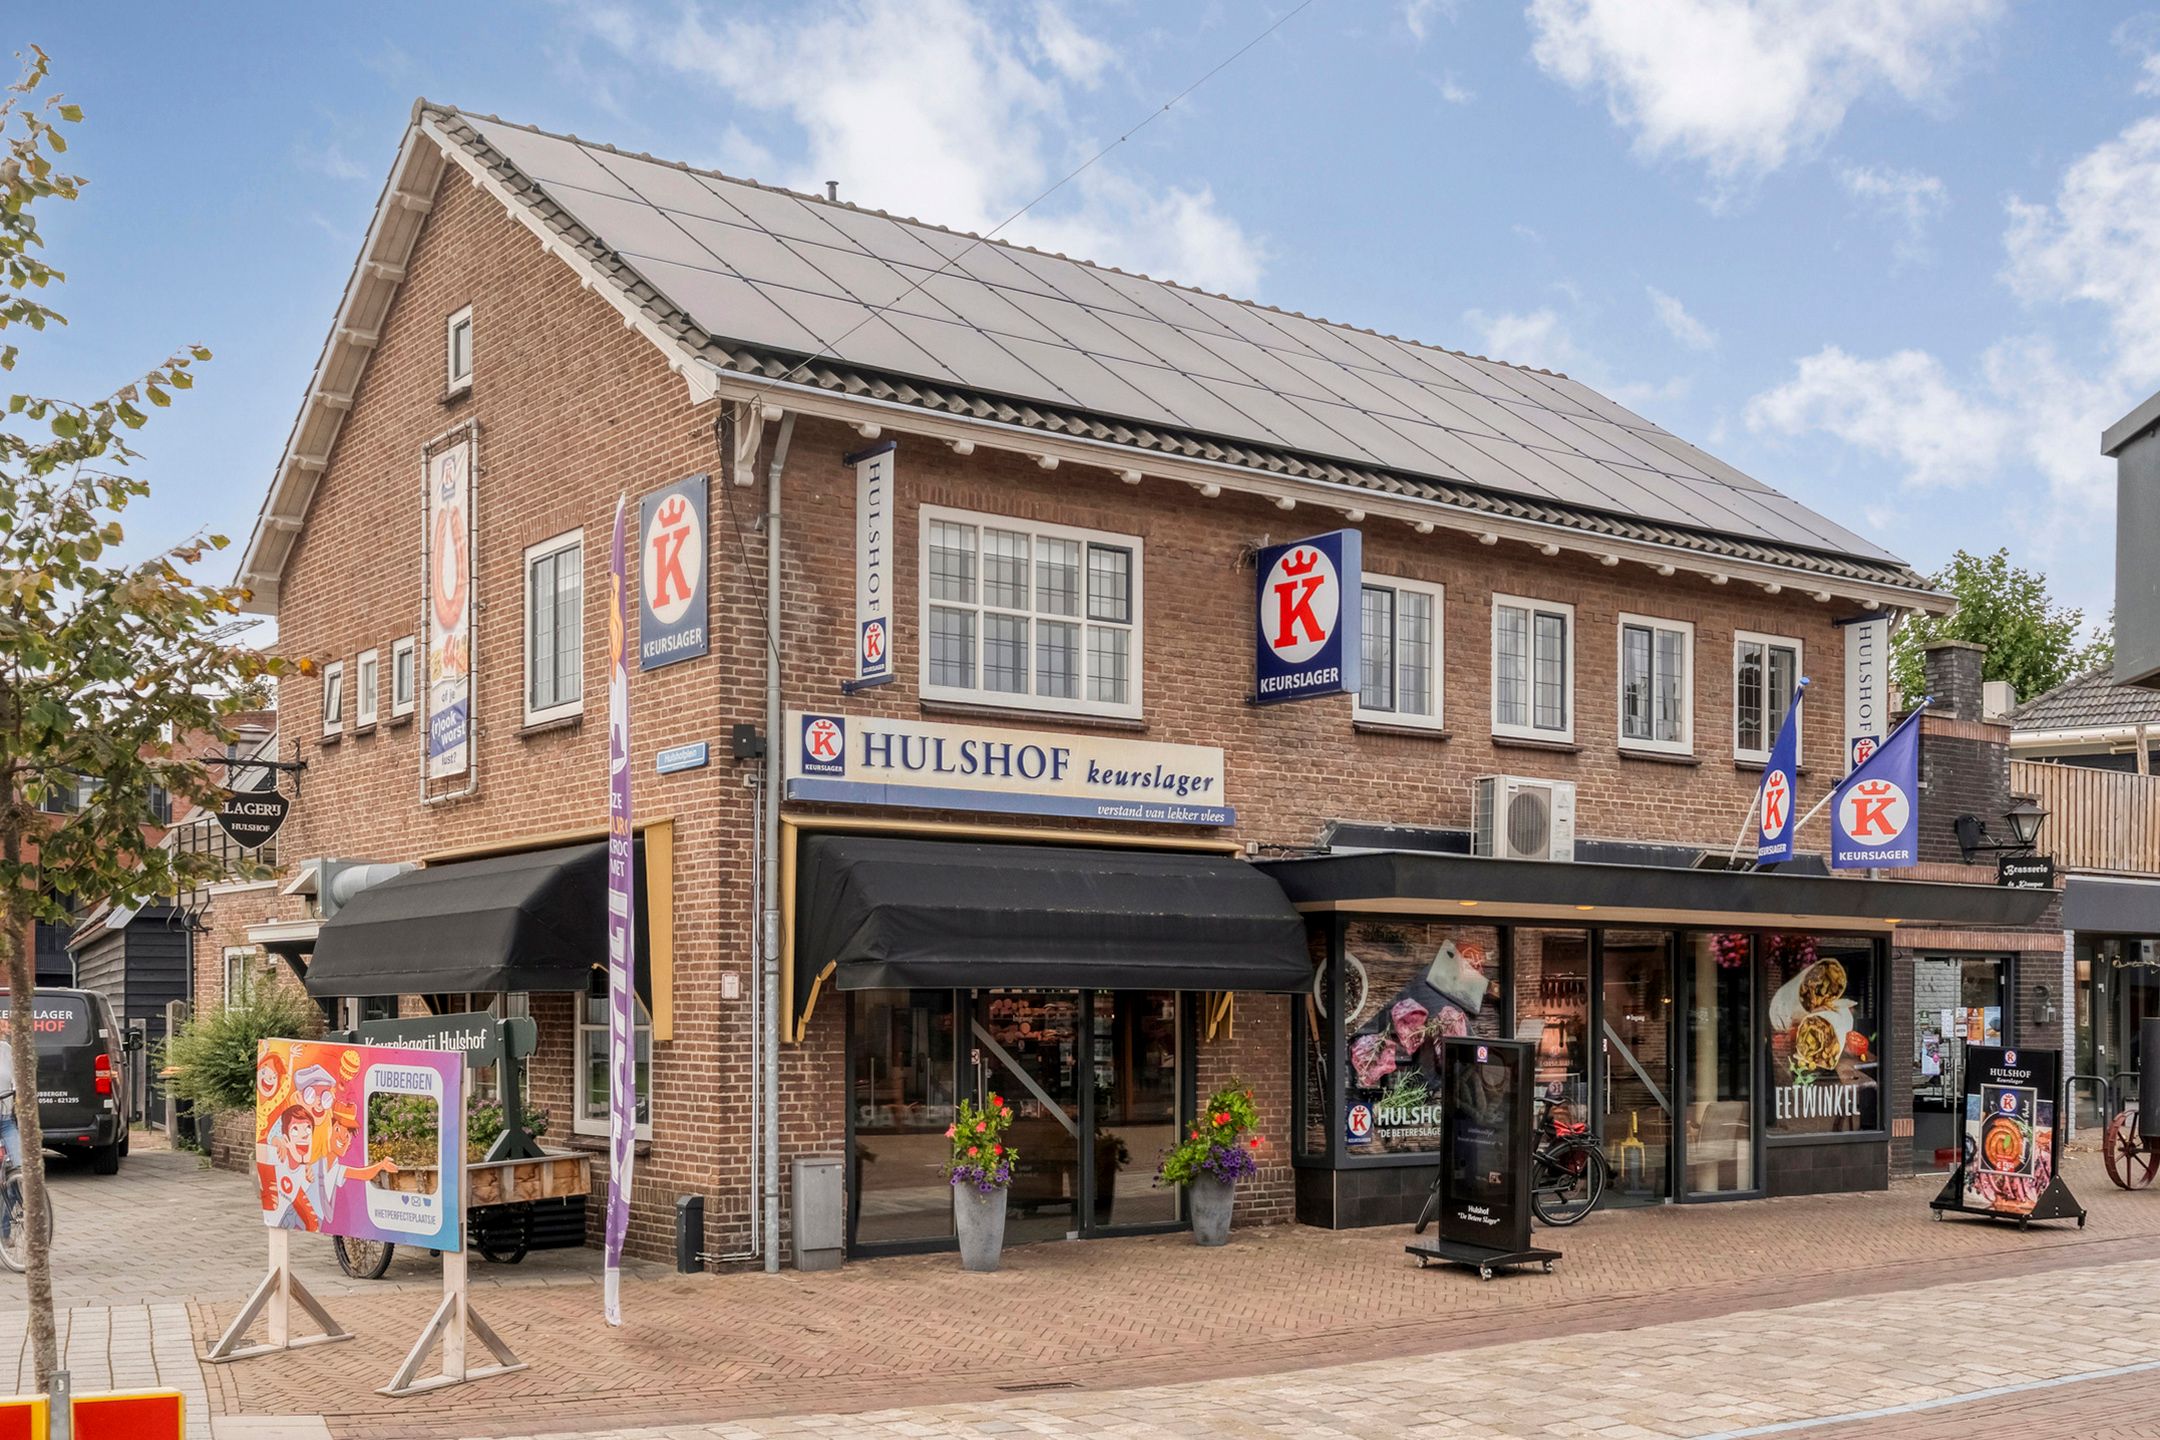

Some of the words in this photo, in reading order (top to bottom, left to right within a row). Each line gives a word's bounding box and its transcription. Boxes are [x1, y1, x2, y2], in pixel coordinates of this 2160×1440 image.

[868, 463, 881, 611] HULSHOF
[653, 525, 691, 609] K
[1274, 575, 1325, 649] K
[643, 627, 703, 659] KEURSLAGER
[867, 633, 881, 658] K
[1260, 667, 1339, 694] KEURSLAGER
[1858, 626, 1873, 732] HULSHOF
[431, 710, 457, 740] (r)ook
[441, 721, 466, 746] worst
[812, 731, 837, 757] K
[861, 731, 1071, 781] HULSHOF
[441, 751, 457, 766] lust?
[805, 763, 843, 773] KEURSLAGER
[1087, 759, 1214, 797] keurslager
[221, 801, 282, 817] LAGERIJ
[1097, 804, 1143, 817] verstand
[1145, 809, 1165, 819] van
[1167, 807, 1199, 822] lekker
[1200, 810, 1225, 823] vlees
[1764, 788, 1785, 831] K
[1851, 797, 1898, 837] K
[231, 822, 271, 832] HULSHOF
[1839, 849, 1909, 861] KEURSLAGER
[2003, 864, 2048, 876] Brasserie
[0, 1010, 73, 1020] ELAGER
[439, 1028, 488, 1051] Hulshof
[375, 1070, 432, 1091] TUBBERGEN
[1989, 1068, 2032, 1079] HULSHOF
[1775, 1084, 1861, 1119] EETWINKEL
[1352, 1113, 1367, 1132] K
[1377, 1105, 1442, 1126] HULSHO
[1391, 1128, 1418, 1138] BETERE
[1419, 1127, 1441, 1136] SLAGE
[1467, 1204, 1490, 1216] Hulshof
